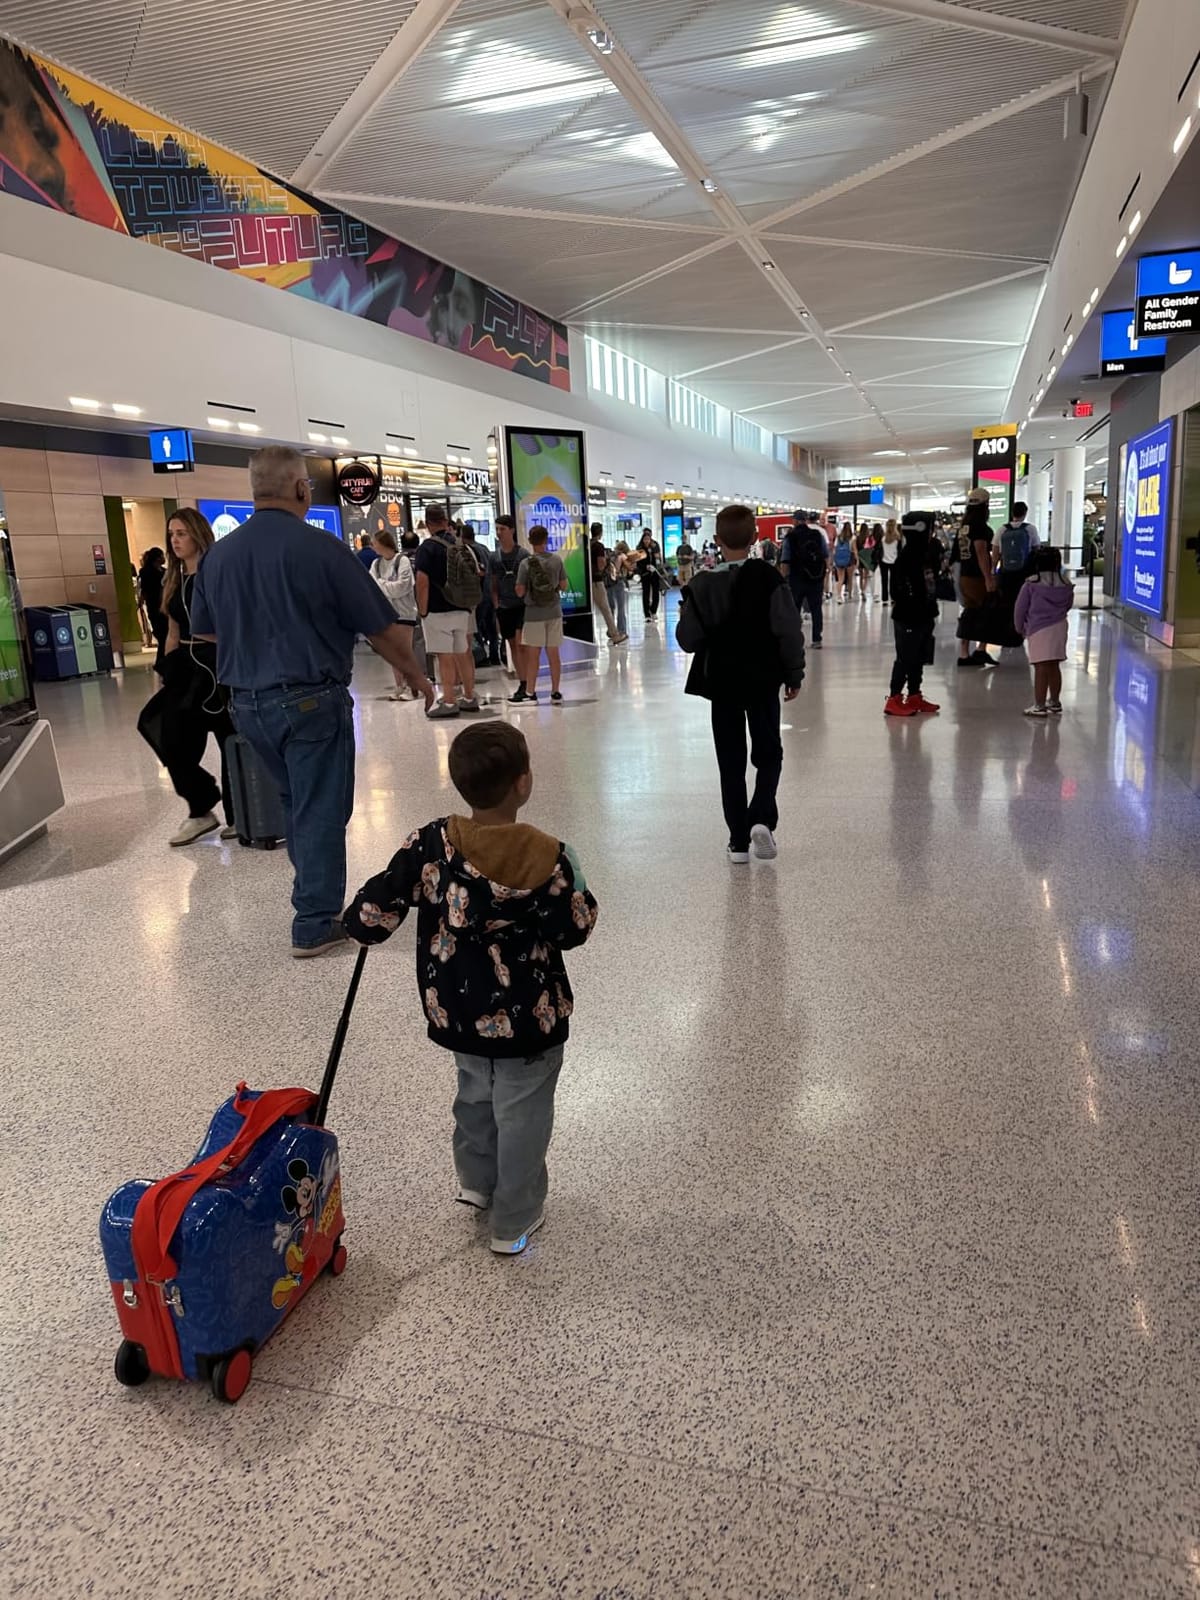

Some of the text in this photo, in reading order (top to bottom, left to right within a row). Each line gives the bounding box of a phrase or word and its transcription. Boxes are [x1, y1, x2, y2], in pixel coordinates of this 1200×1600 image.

[1145, 296, 1199, 309] All Gender
[1144, 309, 1178, 320] Family
[1144, 319, 1192, 331] Restroom
[1106, 363, 1125, 372] Men
[977, 437, 1010, 455] A10
